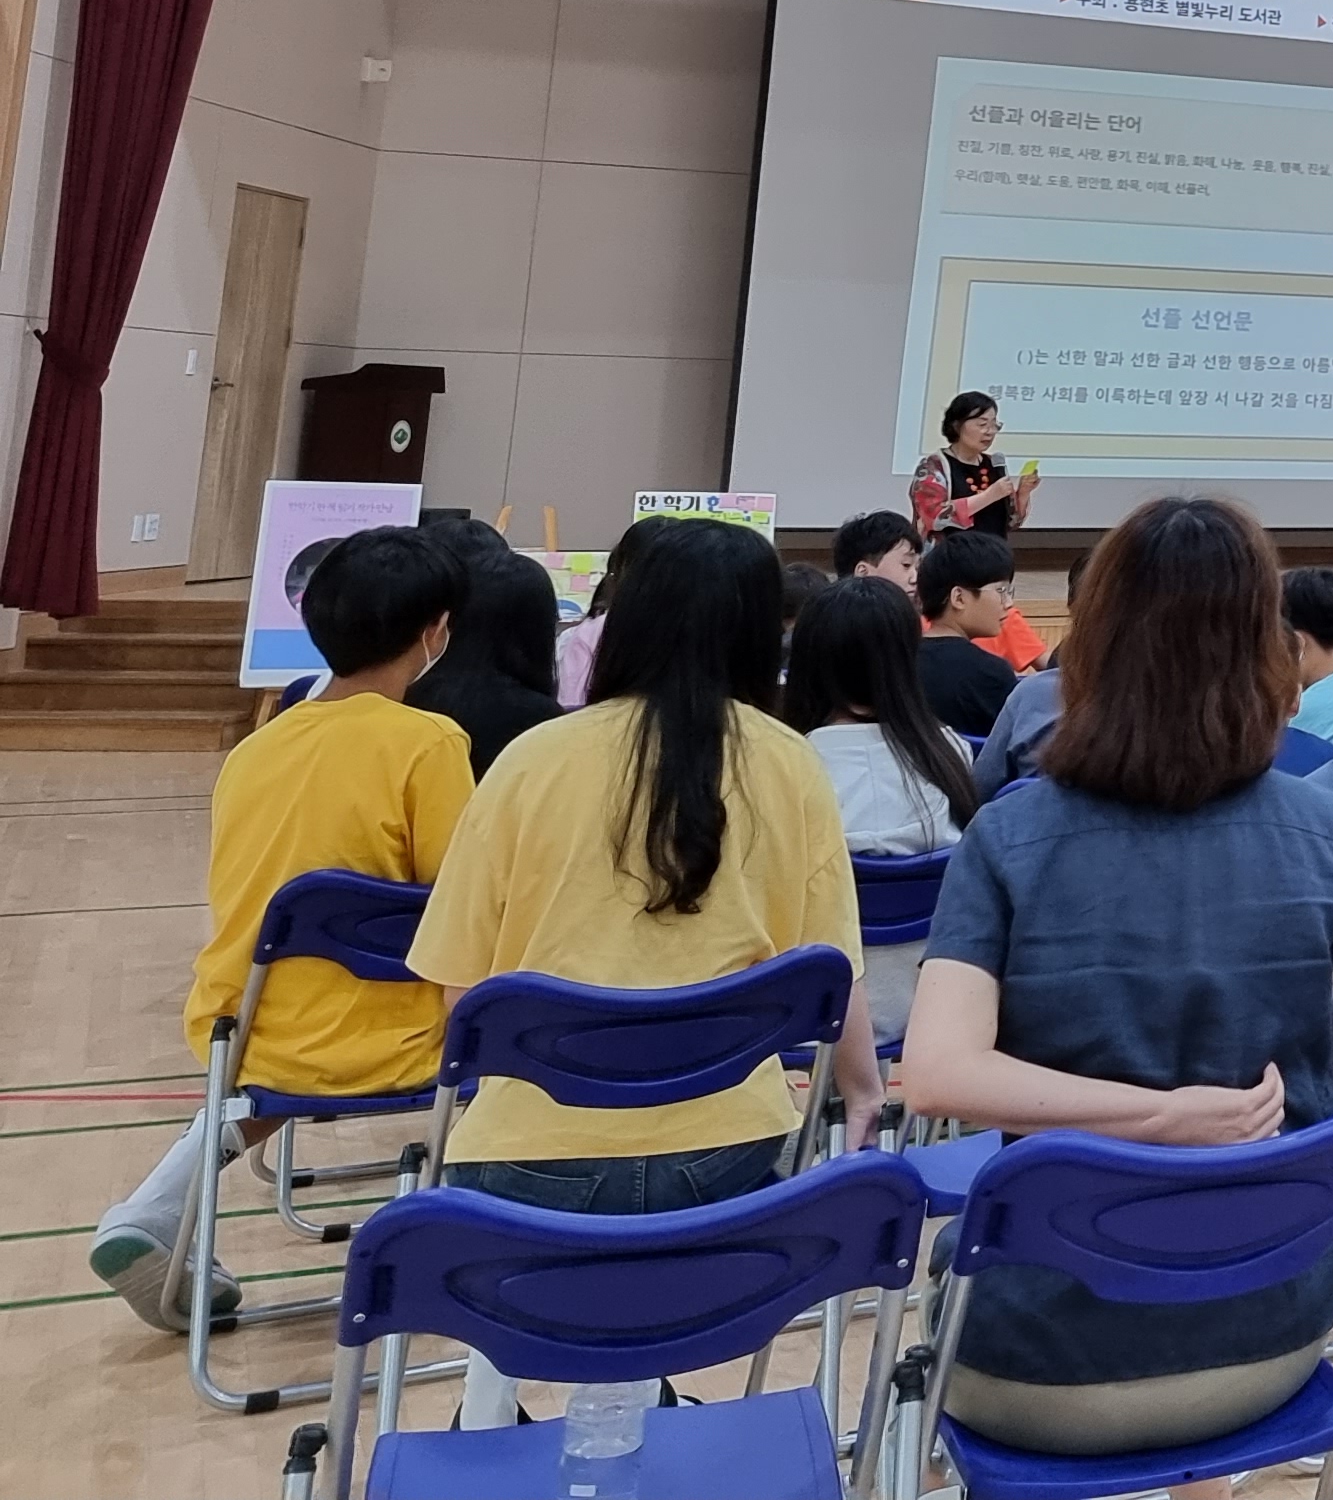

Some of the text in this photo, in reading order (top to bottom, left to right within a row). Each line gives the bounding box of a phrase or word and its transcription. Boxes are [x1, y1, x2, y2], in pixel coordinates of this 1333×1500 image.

[1175, 0, 1233, 22] 별빛누리
[1237, 6, 1282, 26] 도서관
[1030, 108, 1102, 131] 어울리는
[1107, 114, 1143, 133] 단어
[1141, 307, 1253, 332] 선플 선언문
[1056, 349, 1087, 367] 선한
[1093, 350, 1124, 367] 말과
[1130, 352, 1161, 368] 선한
[1167, 352, 1197, 369] 글과
[1202, 354, 1232, 371] 선한
[1237, 355, 1296, 372] 행동으로
[987, 384, 1036, 402] 행복한
[1042, 386, 1088, 404] 사회를
[1095, 387, 1172, 405] 이룩하는데
[1178, 390, 1208, 406] 앞장
[1214, 391, 1229, 407] 서
[1235, 391, 1264, 408] 나갈
[1270, 392, 1299, 409] 것을
[638, 495, 658, 512] 한
[663, 495, 700, 512] 학기
